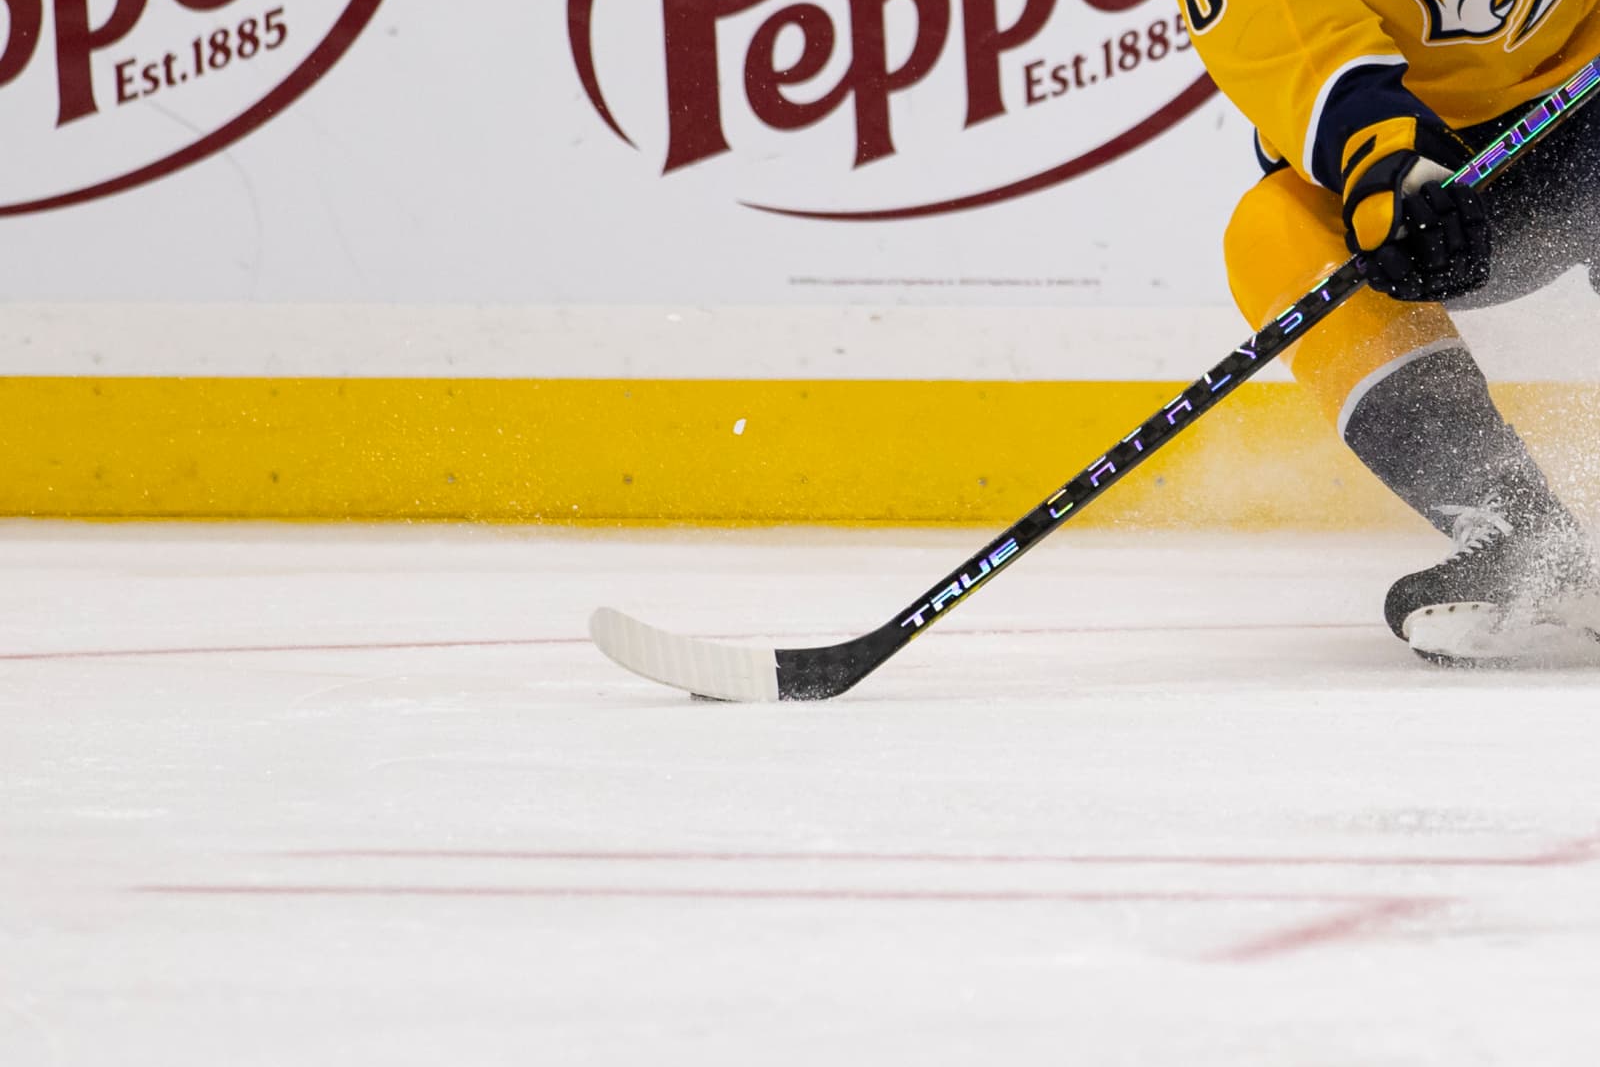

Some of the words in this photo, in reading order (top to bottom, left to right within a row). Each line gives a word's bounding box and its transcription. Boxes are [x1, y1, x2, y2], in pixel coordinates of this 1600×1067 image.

[115, 8, 288, 105] Est.1885
[1047, 277, 1331, 519] CATALYST
[901, 538, 1019, 627] TRUE
